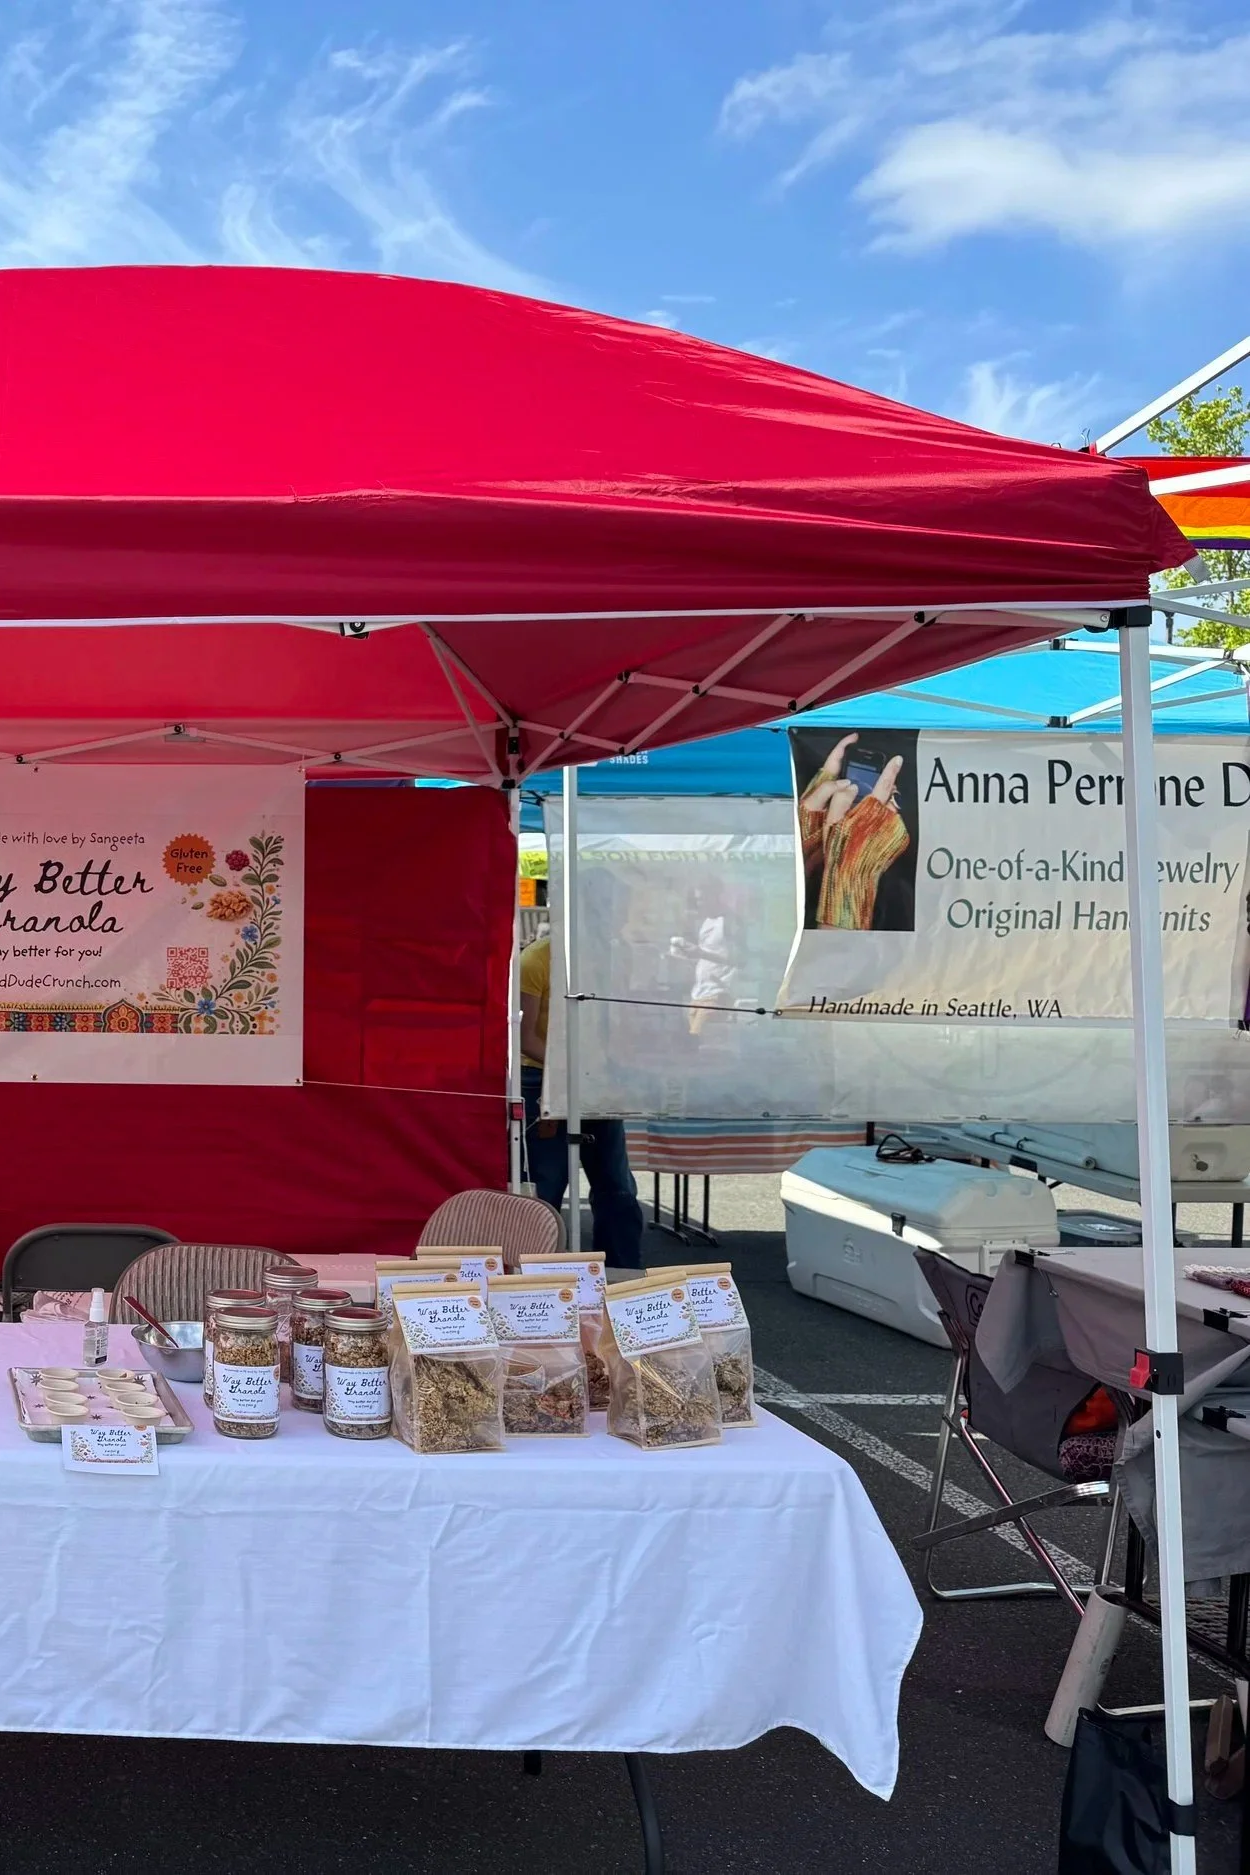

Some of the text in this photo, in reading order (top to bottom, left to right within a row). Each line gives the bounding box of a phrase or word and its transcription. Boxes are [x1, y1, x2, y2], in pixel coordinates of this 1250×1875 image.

[924, 756, 1029, 803] Anna
[10, 831, 39, 845] with
[43, 832, 68, 845] love
[70, 831, 86, 849] by
[89, 832, 145, 851] Sangeeta
[169, 847, 209, 860] Gluten
[177, 861, 202, 875] Free
[926, 847, 1240, 893] One-of-a-Kind ewelry
[33, 859, 154, 896] Better
[947, 898, 1211, 938] Original Hannits
[13, 945, 51, 957] better
[55, 945, 76, 957] for
[79, 945, 103, 960] you!
[808, 996, 1063, 1019] Handmade in Seattle, WA
[691, 1287, 719, 1297] Better
[417, 1305, 470, 1316] Way Better
[625, 1300, 673, 1317] Way Better
[222, 1374, 272, 1386] Way Better
[337, 1376, 387, 1388] Way Better
